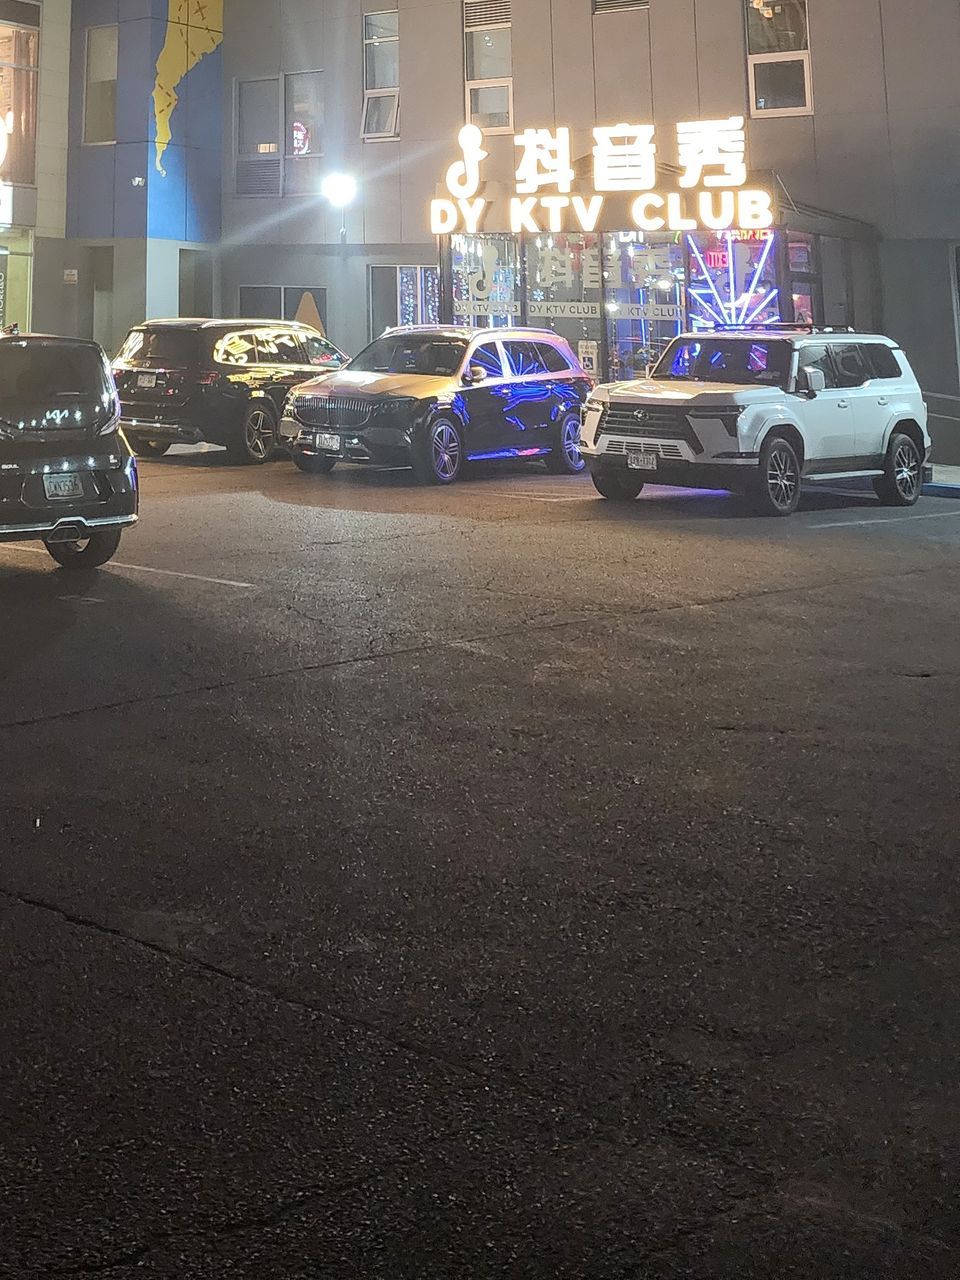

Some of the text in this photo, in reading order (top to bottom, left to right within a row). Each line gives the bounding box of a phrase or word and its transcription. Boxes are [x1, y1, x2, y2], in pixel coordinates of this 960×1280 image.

[513, 115, 748, 194] 抖音秀
[430, 190, 774, 235] DY KTV CLUB
[529, 305, 544, 314] DY
[546, 305, 566, 314] KTV
[569, 306, 598, 315] CLUB
